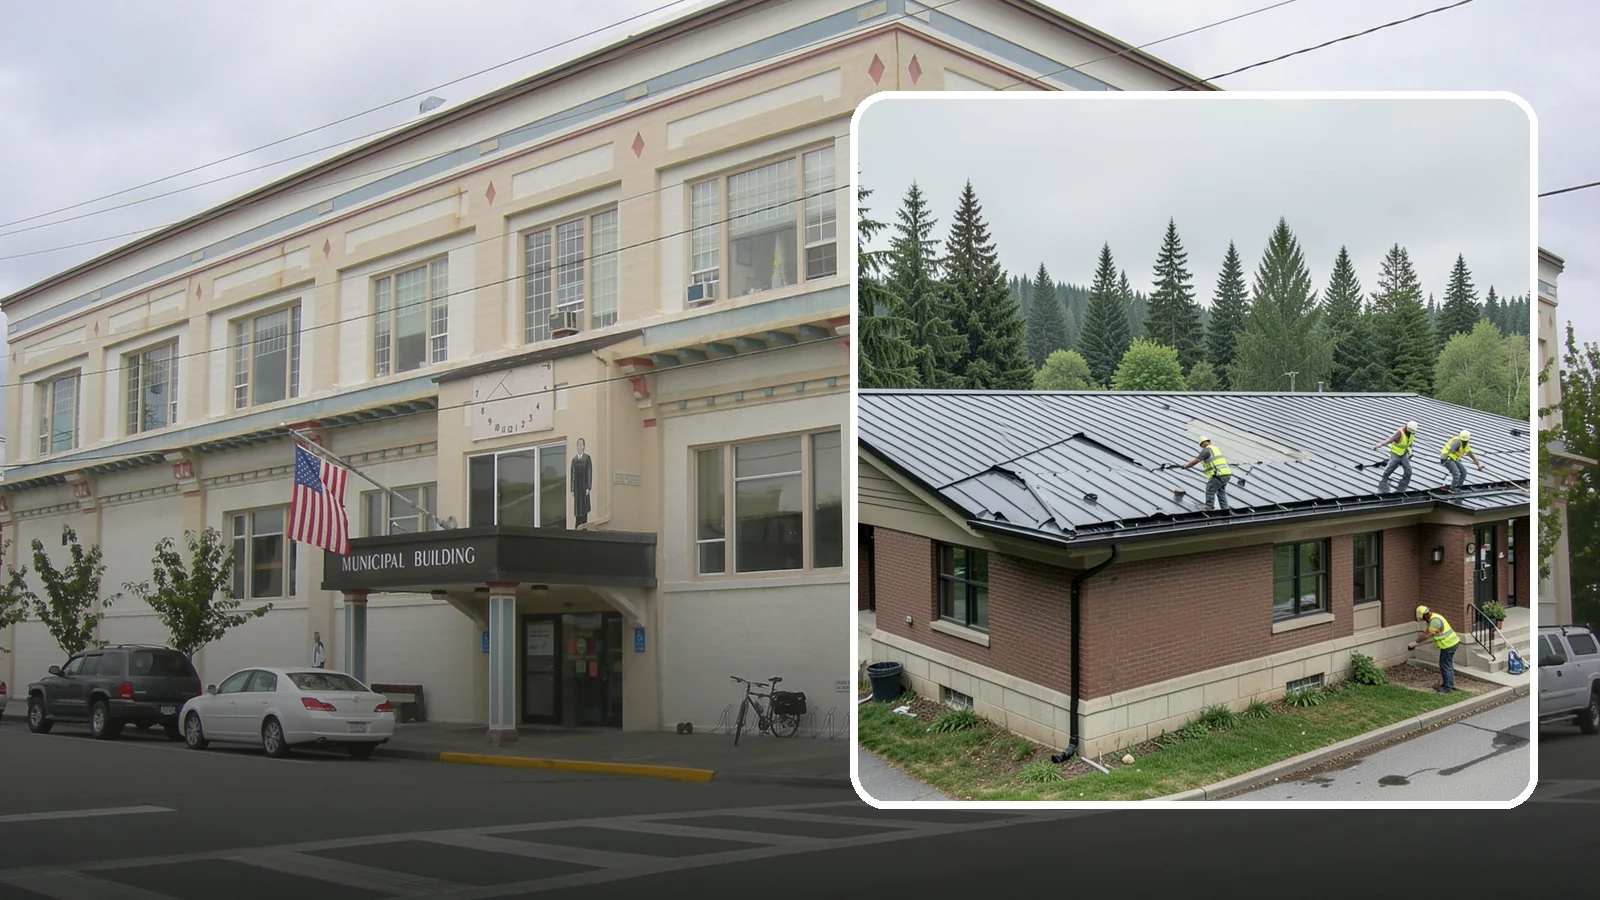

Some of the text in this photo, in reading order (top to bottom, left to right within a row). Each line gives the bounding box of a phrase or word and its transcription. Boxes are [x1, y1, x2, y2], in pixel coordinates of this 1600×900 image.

[475, 390, 479, 398] 7
[536, 402, 540, 410] 4
[480, 407, 485, 415] 8
[488, 417, 493, 426] 9
[528, 414, 533, 422] 3
[521, 420, 525, 428] 2
[507, 425, 513, 433] 12
[342, 546, 475, 571] MUNICIPAL BUILDING
